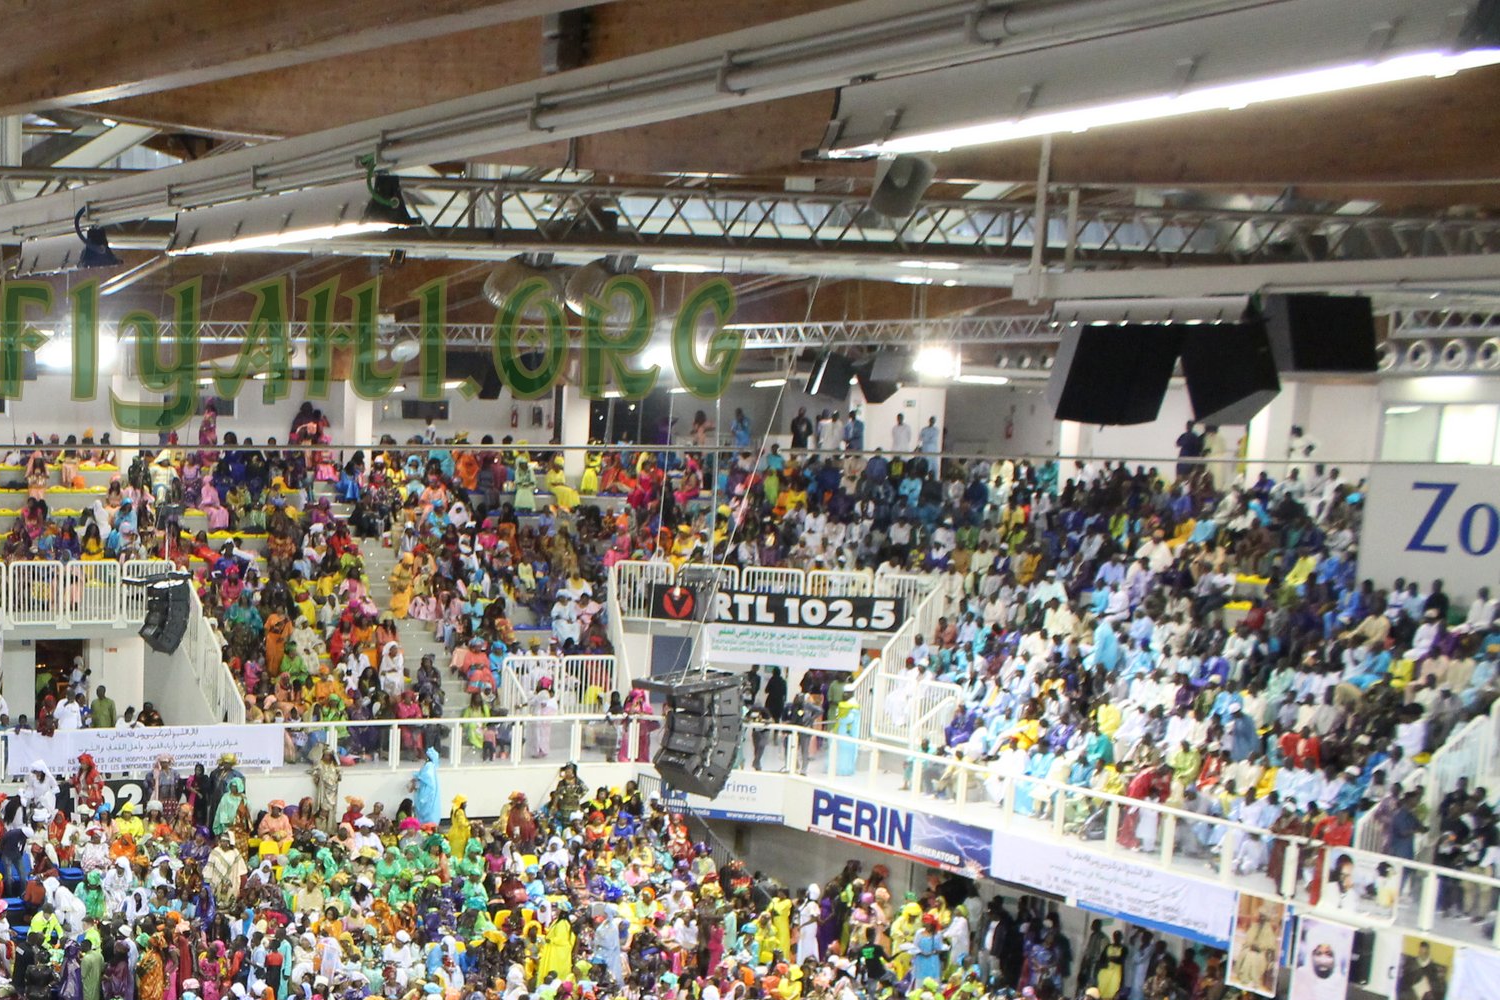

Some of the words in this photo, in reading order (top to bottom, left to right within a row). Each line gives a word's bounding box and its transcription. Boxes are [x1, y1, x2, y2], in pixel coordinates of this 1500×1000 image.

[715, 591, 775, 624] RTL
[784, 597, 896, 630] 102.5
[811, 788, 914, 851] PERIN
[912, 843, 961, 866] GENERATORS
